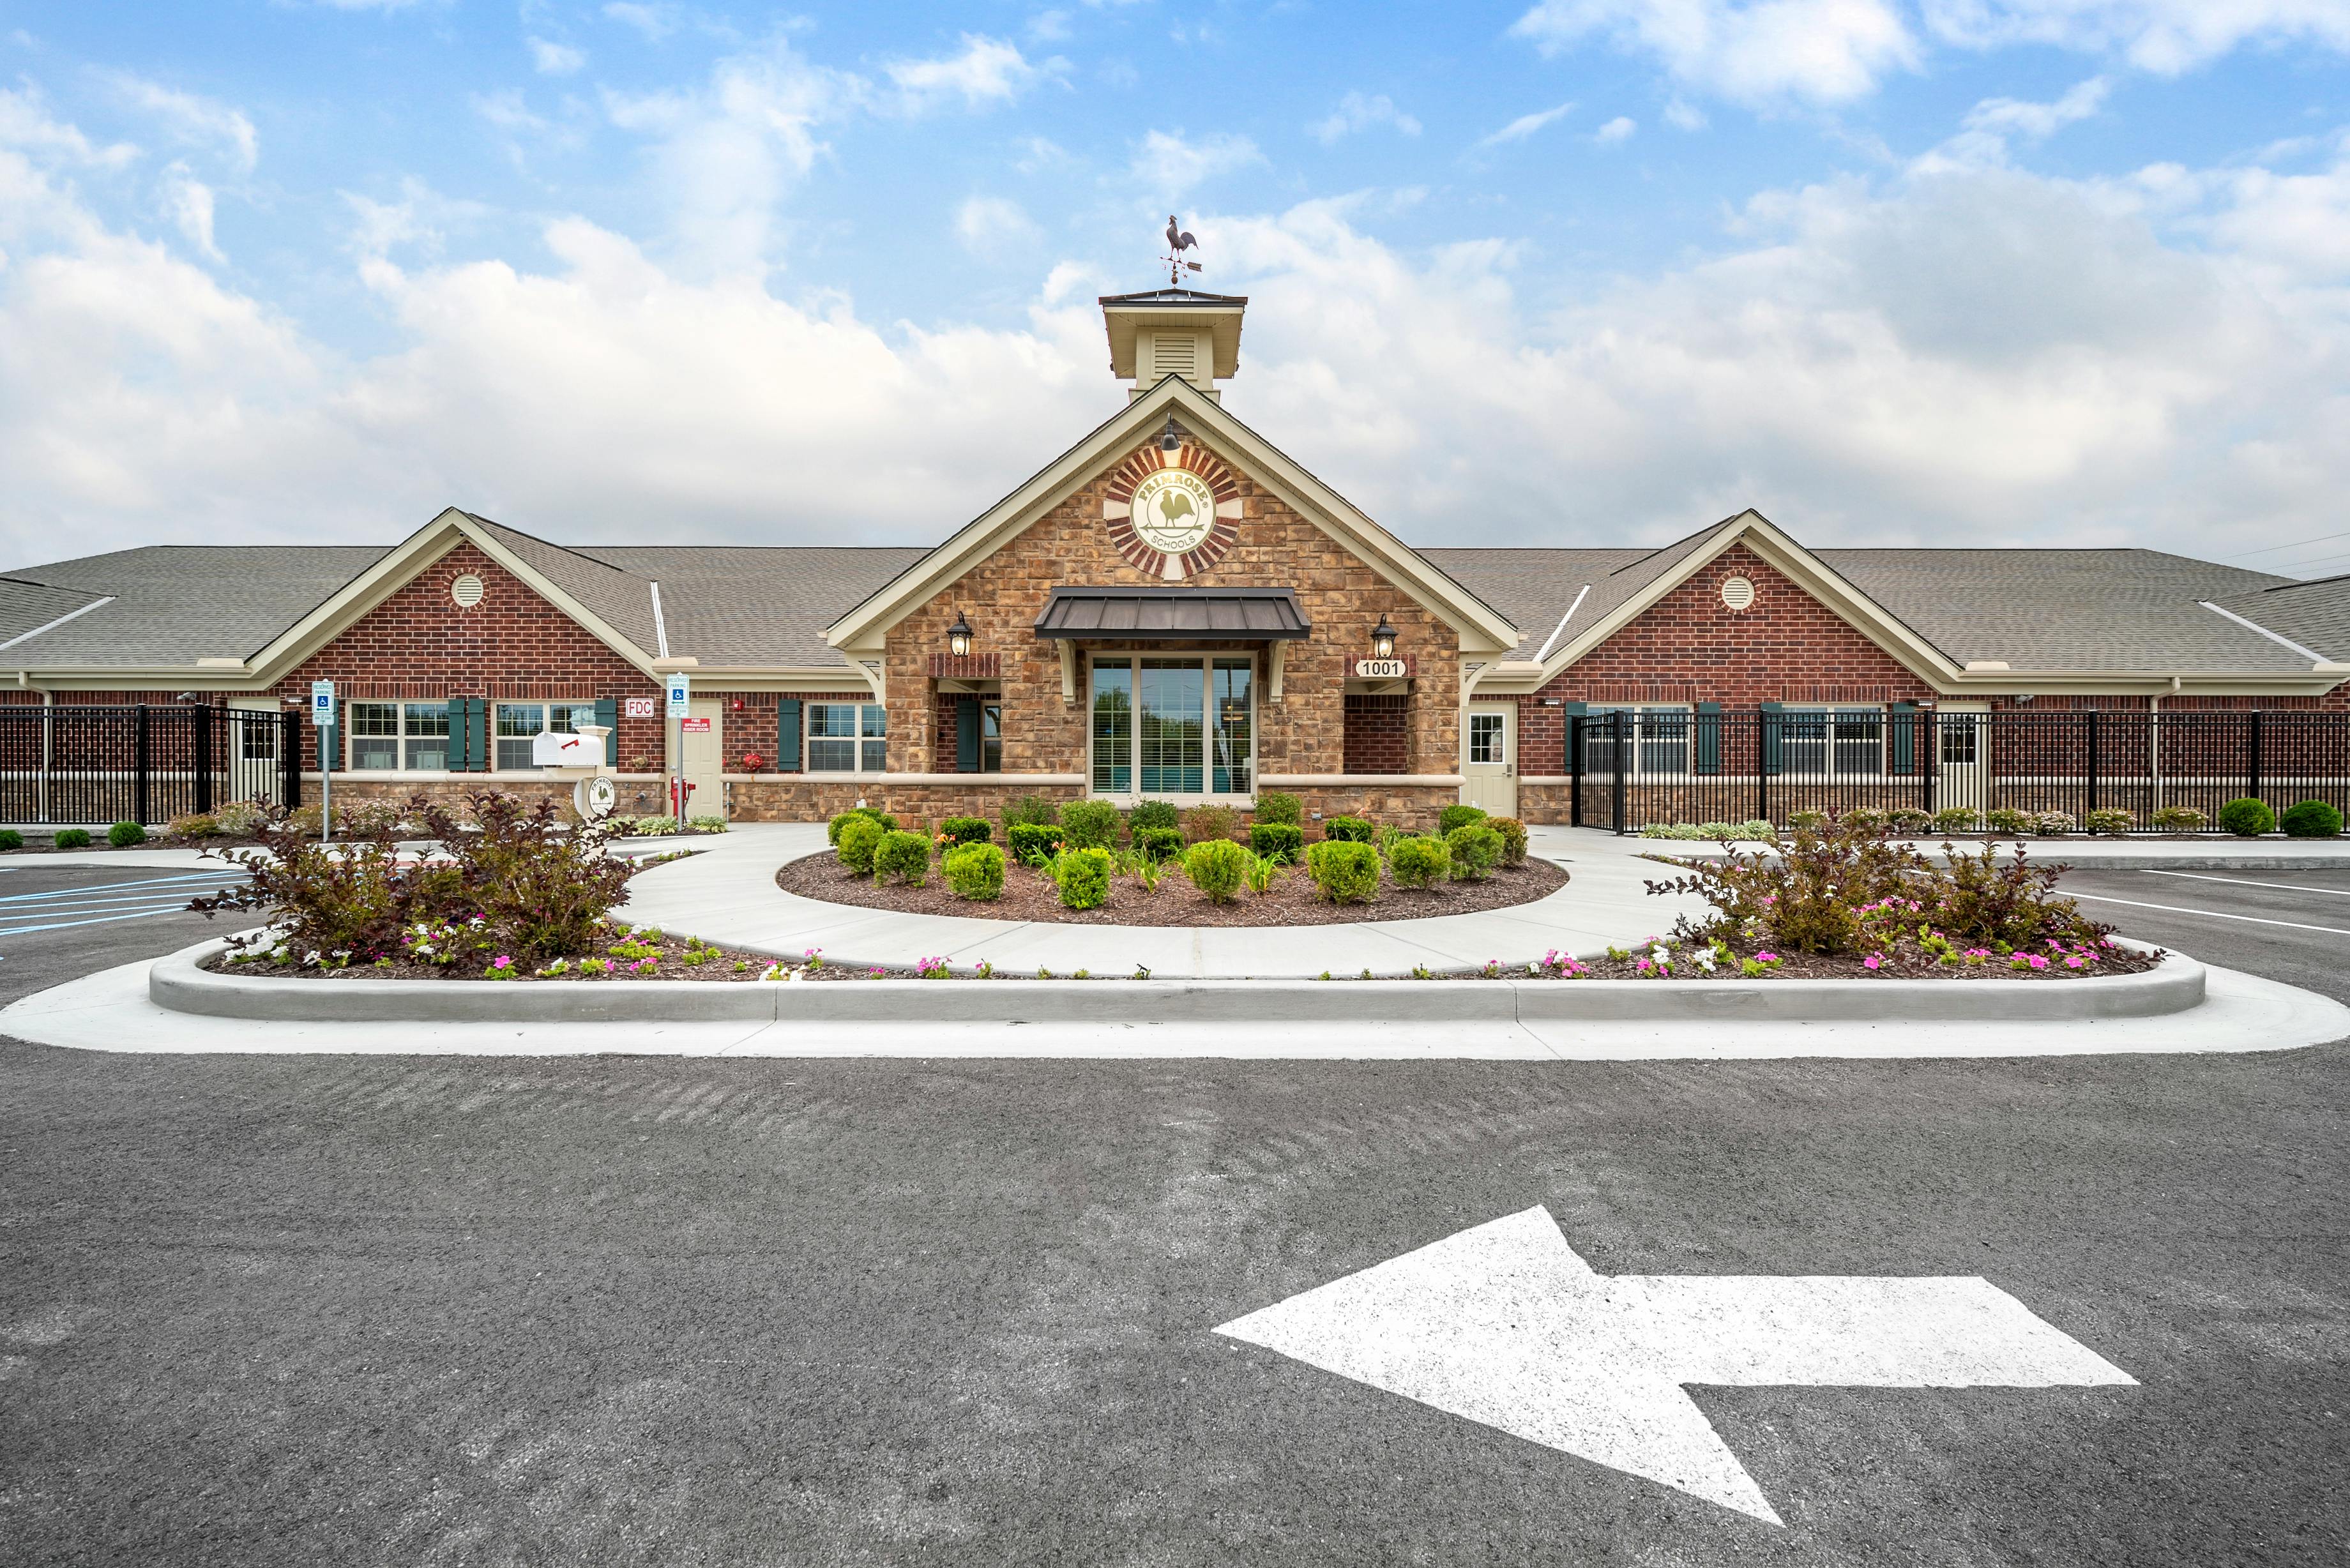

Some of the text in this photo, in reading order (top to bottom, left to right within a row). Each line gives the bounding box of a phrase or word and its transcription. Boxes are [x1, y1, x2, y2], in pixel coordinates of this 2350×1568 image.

[1138, 474, 1208, 502] PRIMROSE
[1151, 535, 1195, 549] SCHOOLS
[1363, 662, 1398, 675] 1001
[629, 702, 651, 714] FDC
[591, 778, 613, 791] PRIMROSE
